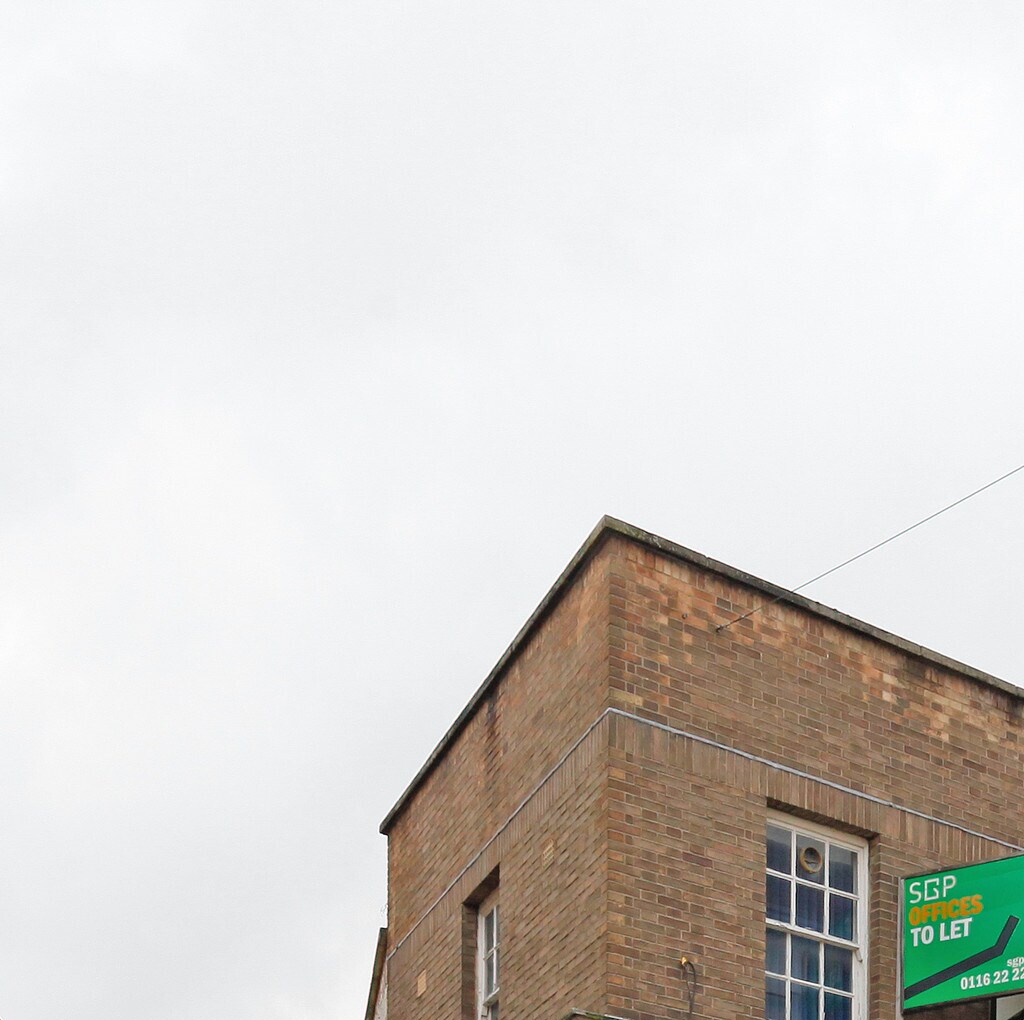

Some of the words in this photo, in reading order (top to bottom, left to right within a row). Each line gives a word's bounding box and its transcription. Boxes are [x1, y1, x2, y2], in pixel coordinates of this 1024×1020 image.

[909, 875, 956, 904] SGP
[909, 894, 983, 926] OFFICES
[910, 925, 934, 947] TO
[939, 917, 973, 941] LET
[960, 973, 990, 990] 0116
[993, 969, 1009, 985] 22
